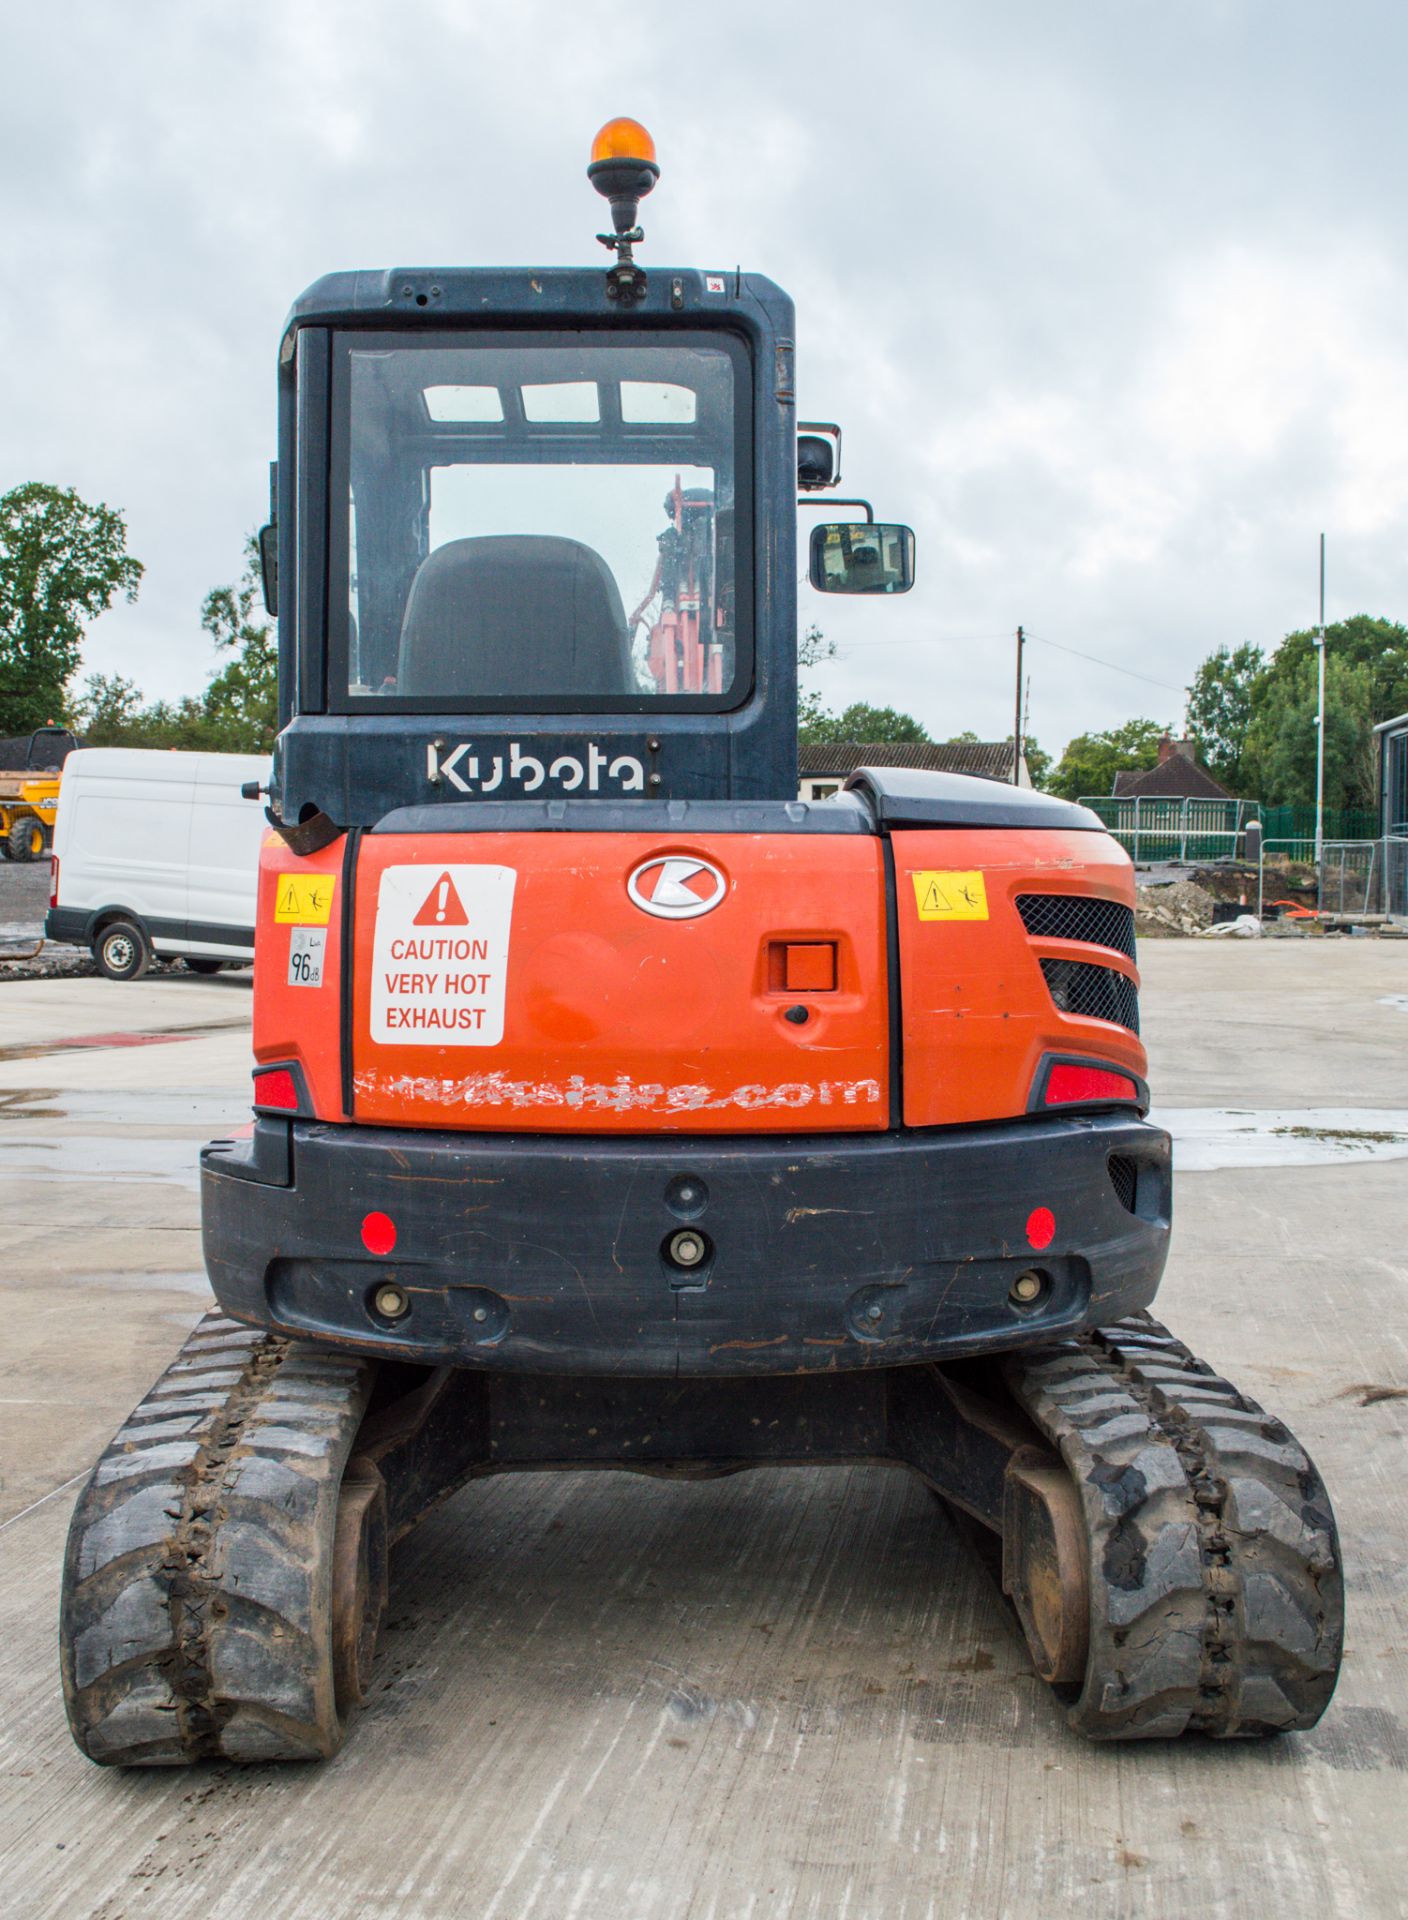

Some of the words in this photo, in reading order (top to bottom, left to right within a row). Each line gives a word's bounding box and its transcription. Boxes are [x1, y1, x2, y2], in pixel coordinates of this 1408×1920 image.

[427, 742, 644, 792] Kubota
[390, 939, 488, 960] CAUTION
[385, 973, 438, 994] VERY
[444, 973, 491, 995] HOT
[386, 1007, 486, 1030] EXHAUST
